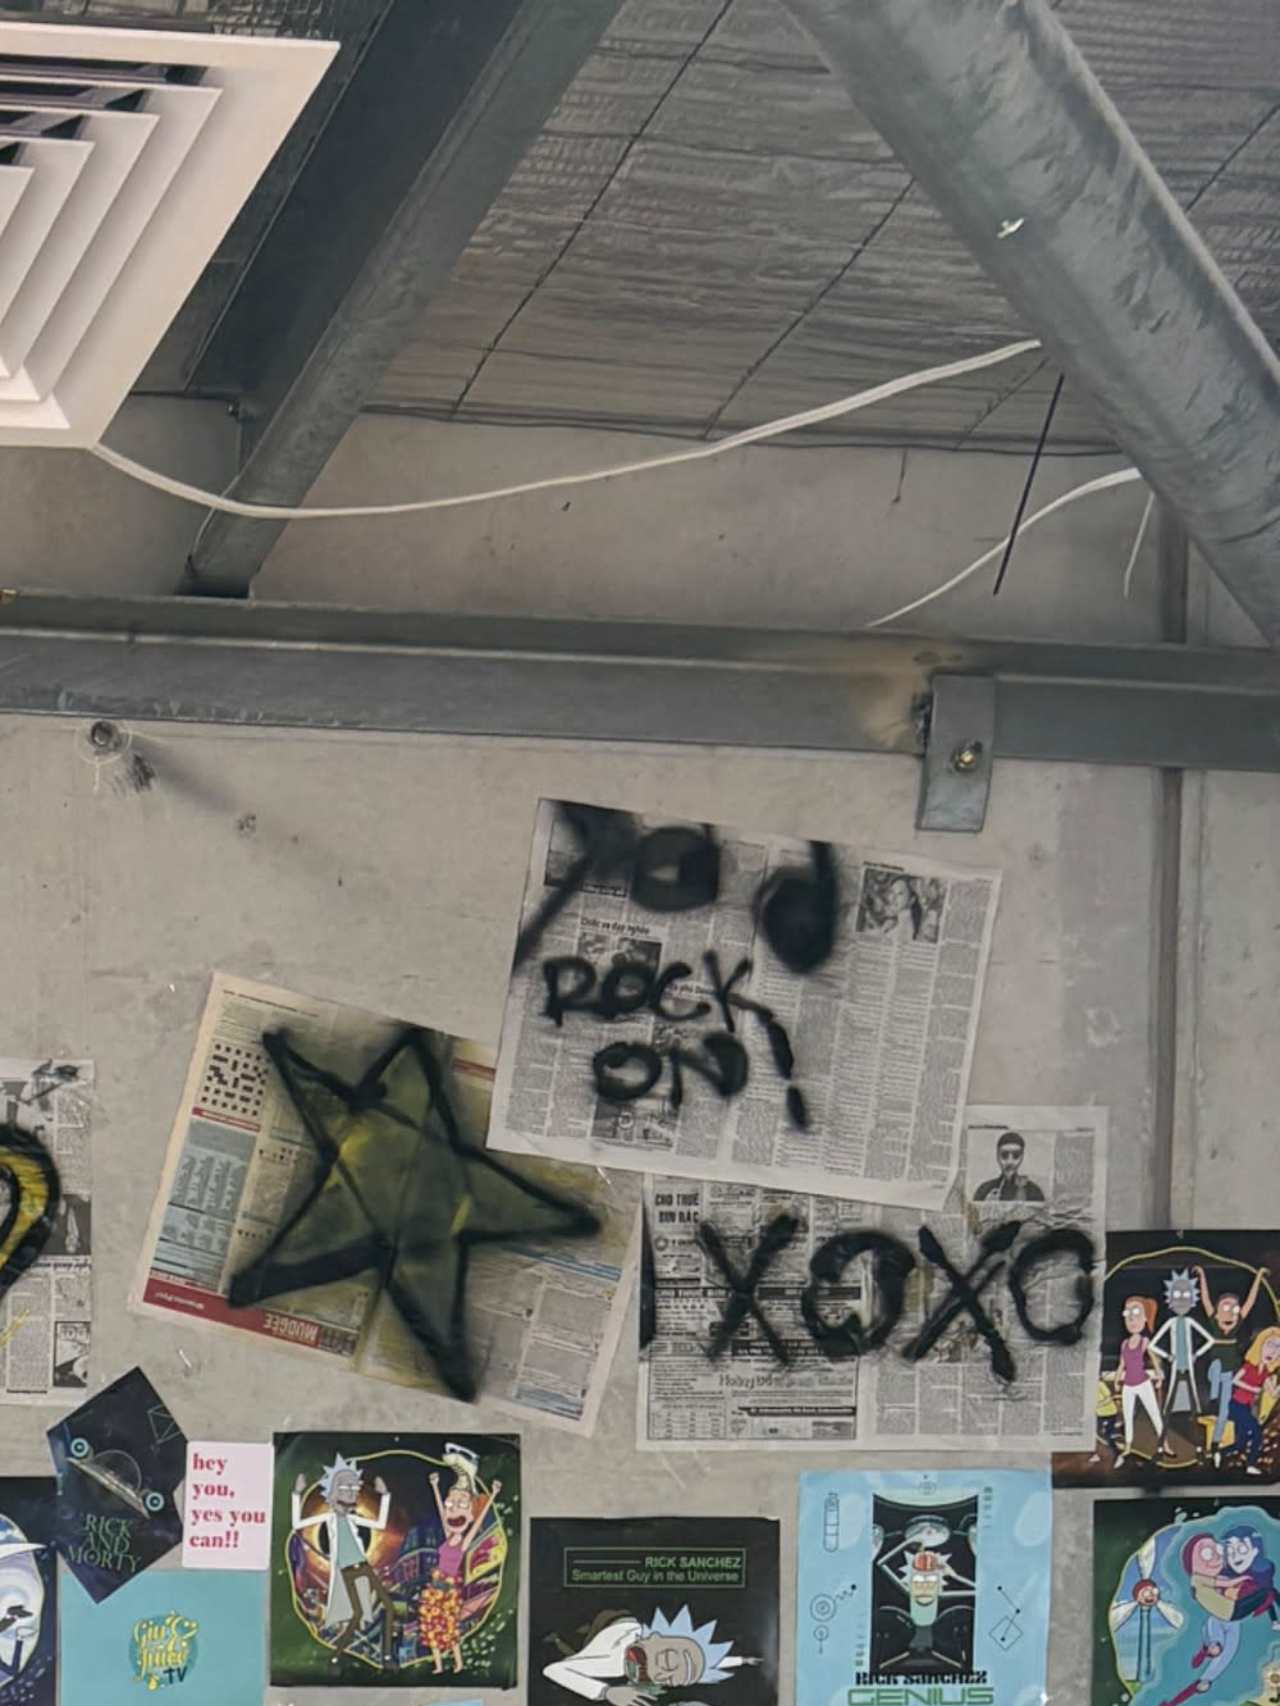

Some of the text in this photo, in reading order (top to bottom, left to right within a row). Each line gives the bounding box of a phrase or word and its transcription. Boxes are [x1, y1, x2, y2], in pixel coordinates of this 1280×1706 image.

[542, 948, 753, 1033] ROCK
[698, 1211, 1097, 1384] XOXO
[192, 1453, 228, 1475] hey
[192, 1481, 236, 1499] you,
[83, 1514, 133, 1539] RICK
[191, 1508, 267, 1527] yes you
[189, 1530, 240, 1548] can!!
[67, 1545, 144, 1573] MORTY
[645, 1557, 742, 1568] RICK SANCHEZ
[571, 1569, 739, 1583] Smartest Guy in the Universe
